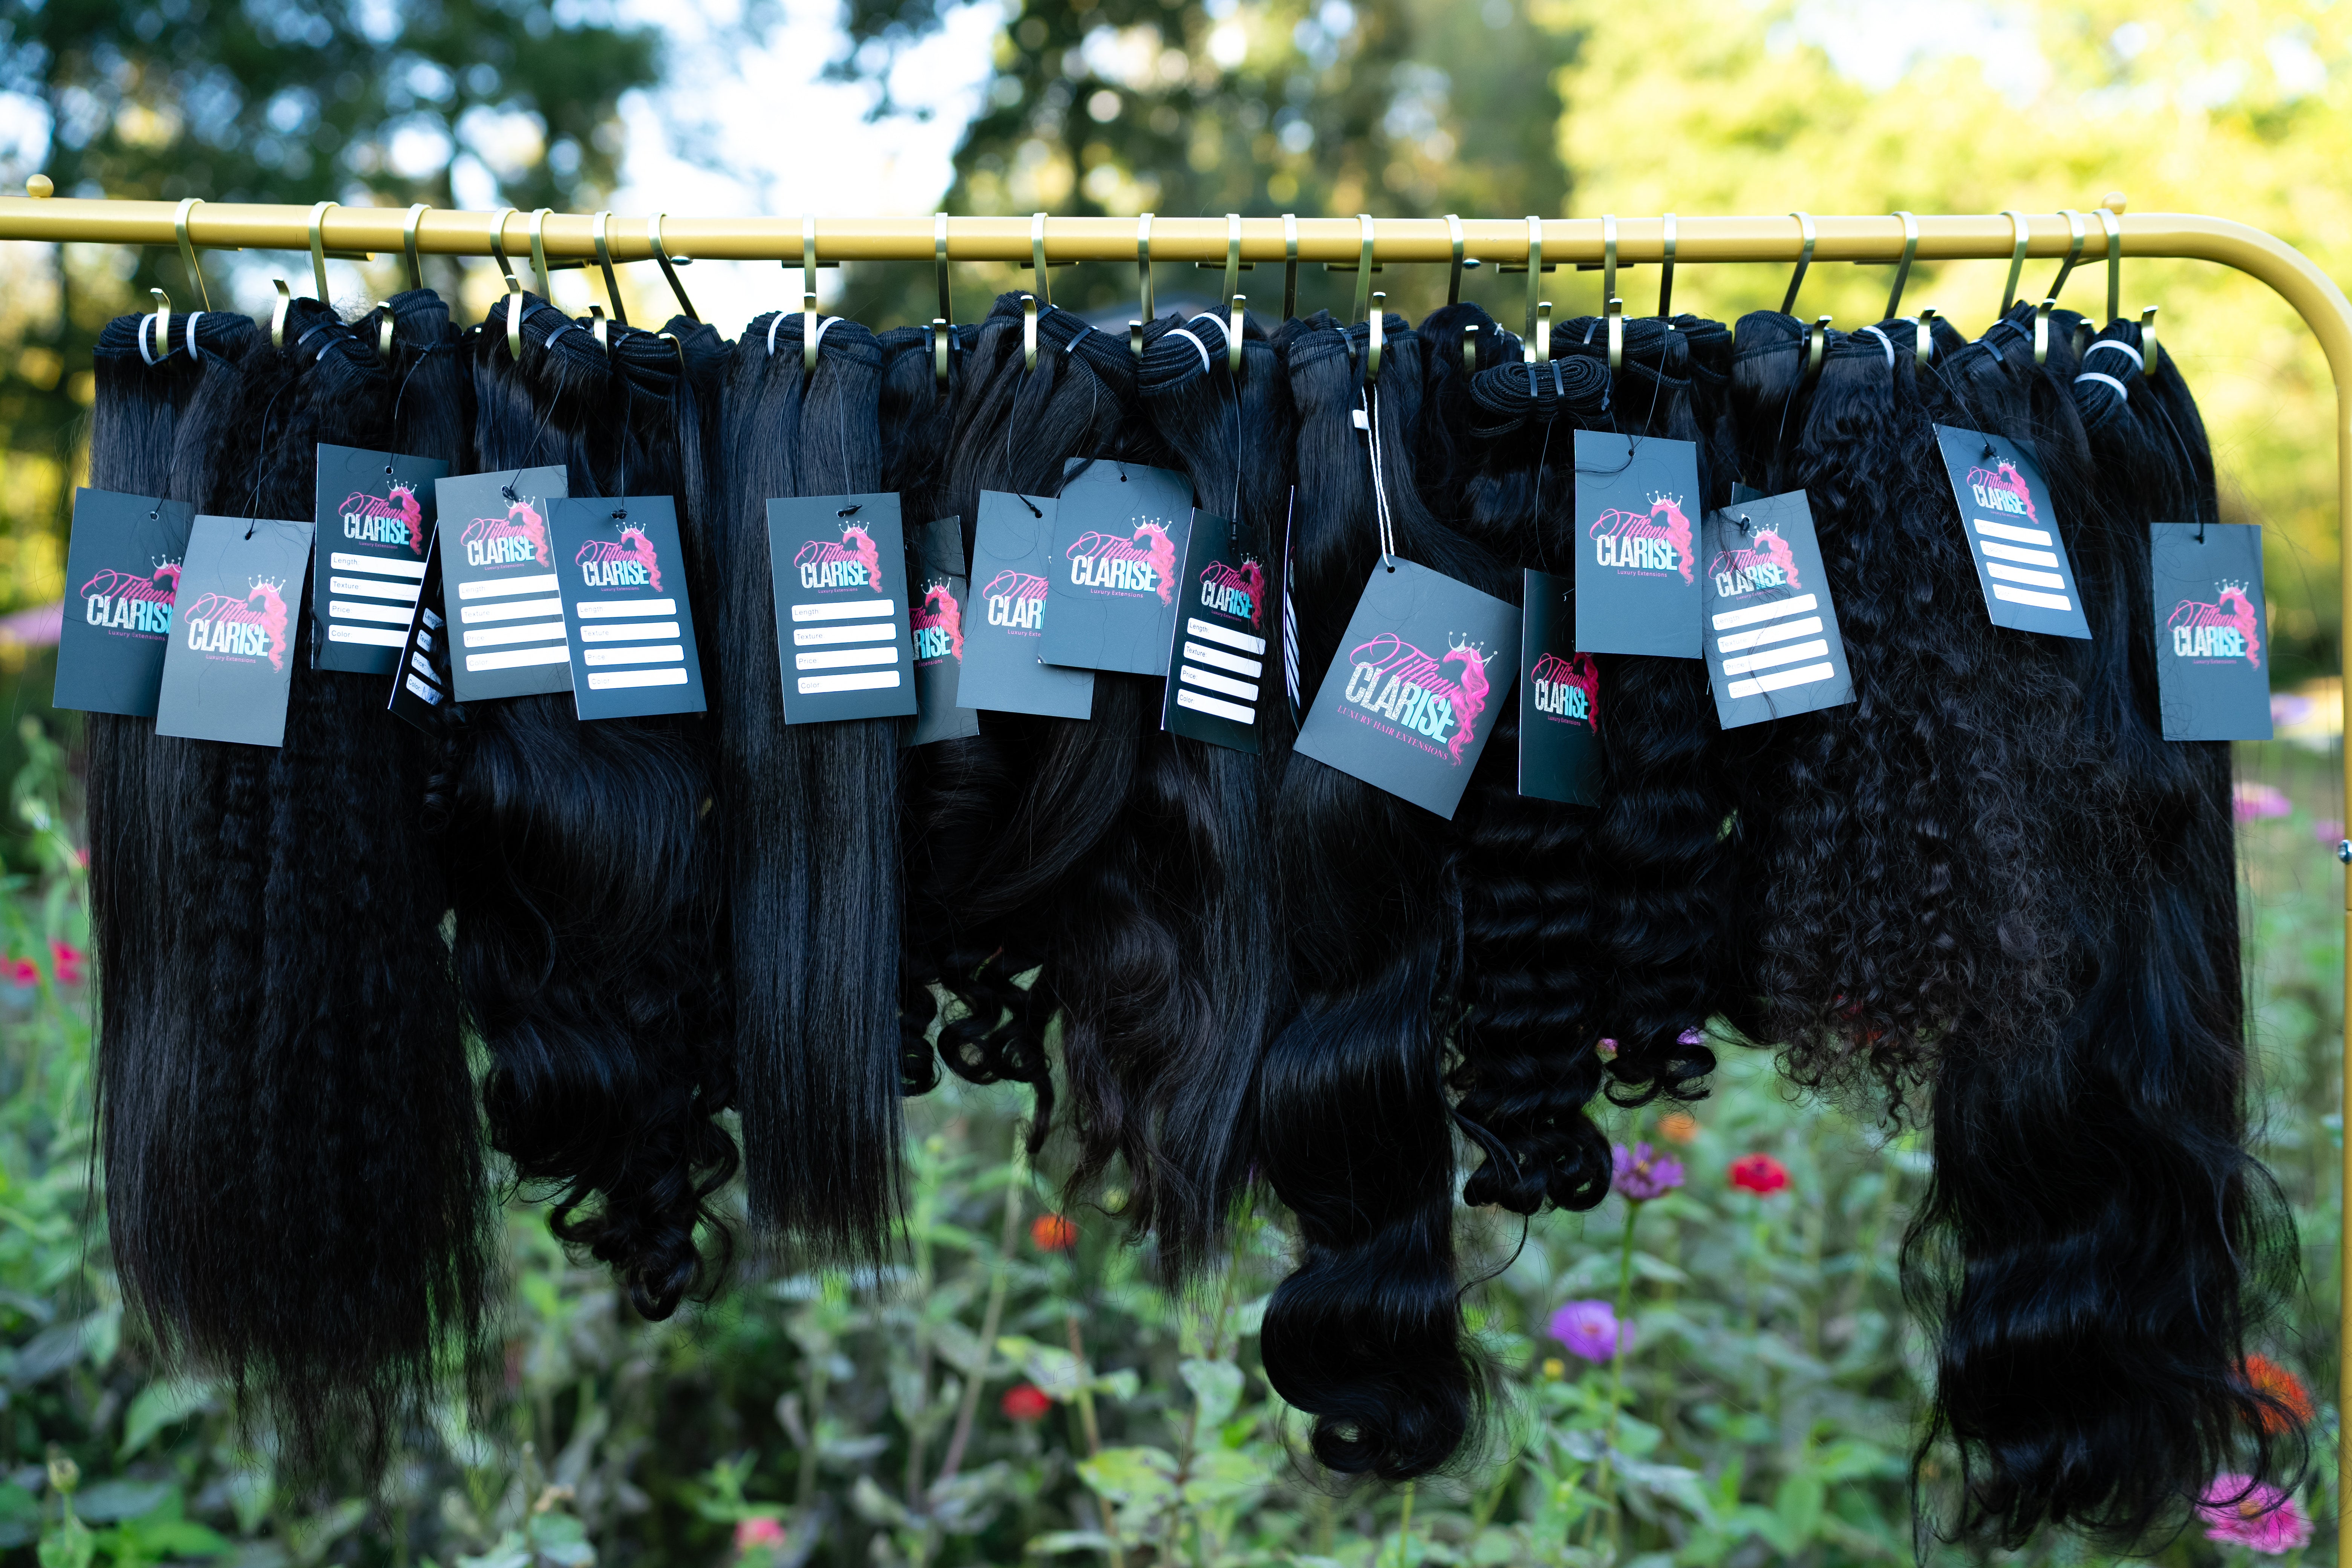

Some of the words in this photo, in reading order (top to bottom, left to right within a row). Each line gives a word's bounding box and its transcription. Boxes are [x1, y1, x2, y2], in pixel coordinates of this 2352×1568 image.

[1966, 466, 2014, 496] Tiffany
[338, 492, 404, 524] Tiffany
[1972, 484, 2027, 515] CLARISE
[344, 512, 409, 545] CLARISE
[461, 518, 526, 547] Tiffany
[1589, 508, 1671, 546] Tiffany
[467, 535, 536, 566] CLARISE
[575, 540, 638, 570] Tiffany
[794, 540, 860, 571] Tiffany
[1066, 531, 1153, 568] Tiffany
[1596, 534, 1678, 571] CLARISE
[1708, 547, 1773, 579] Tiffany
[80, 569, 174, 609] Tiffany
[582, 560, 649, 586] CLARISE
[801, 560, 869, 589] CLARISE
[983, 570, 1049, 605] Tiffa
[1071, 555, 1157, 592] CLARISE
[1200, 560, 1250, 597] Tiffany
[1715, 562, 1786, 597] CLARISE
[184, 592, 266, 631] Tiffany
[988, 594, 1046, 629] CLAR
[1201, 580, 1253, 619] CLARISE
[909, 605, 942, 637] iffany
[1190, 622, 1209, 633] Length:
[1223, 613, 1242, 622] Extensions
[2168, 600, 2237, 633] Tiffany
[108, 629, 130, 638] Luxury
[132, 632, 165, 641] Extensions
[188, 618, 270, 657] CLARISE
[912, 625, 951, 660] RISE
[2173, 625, 2246, 657] CLARISE
[226, 655, 256, 664] Extensions
[918, 659, 943, 667] Extensions
[1187, 646, 1207, 657] Texture:
[1183, 670, 1197, 680] Price:
[1349, 632, 1460, 704] Tiffany
[1531, 653, 1585, 694] Tiffany
[1179, 694, 1194, 704] Color:
[1345, 662, 1455, 744] CLARISE
[1535, 678, 1588, 720] CLARISE
[1337, 705, 1372, 726] LUXURY
[1374, 721, 1395, 737] HAIR
[1396, 731, 1449, 761] EXTENSIONS
[1548, 715, 1561, 723] Luxury
[1561, 717, 1580, 726] Extensions
